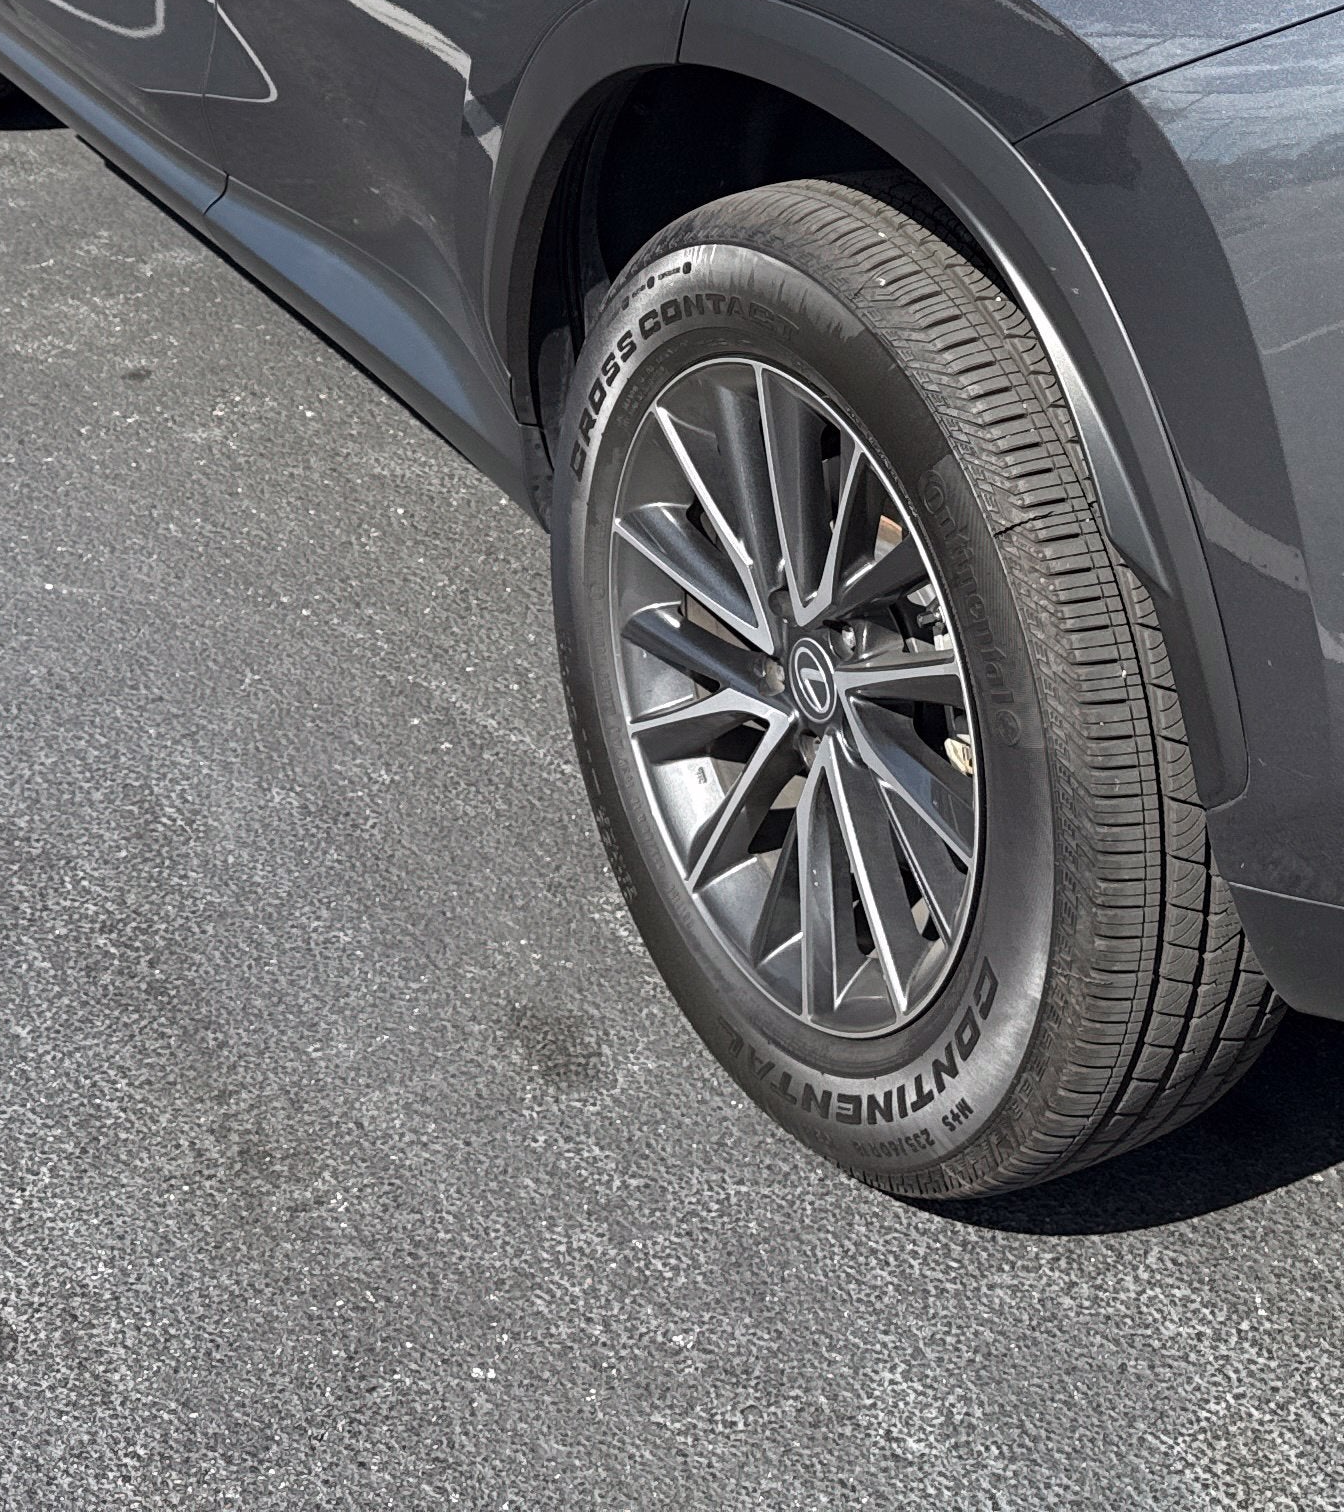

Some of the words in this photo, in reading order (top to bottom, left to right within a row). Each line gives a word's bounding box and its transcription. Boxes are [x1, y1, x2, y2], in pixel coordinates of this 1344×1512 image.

[570, 329, 638, 483] CROSS
[638, 293, 800, 341] CONTACT
[717, 955, 999, 1126] CONTINENTAL
[941, 1096, 974, 1132] M+S
